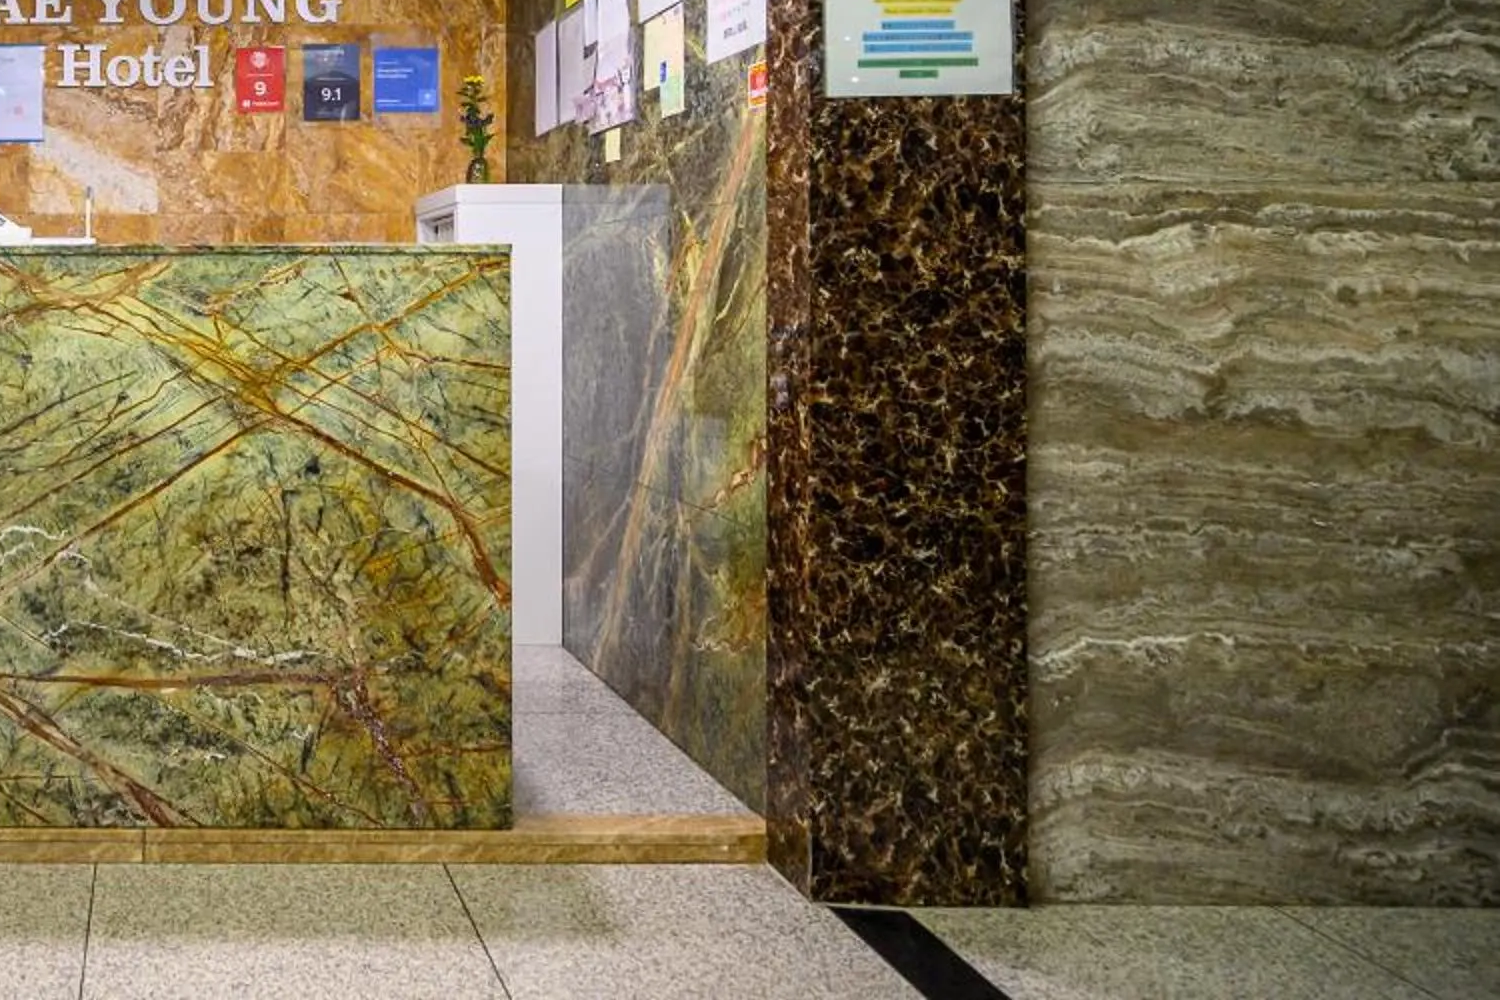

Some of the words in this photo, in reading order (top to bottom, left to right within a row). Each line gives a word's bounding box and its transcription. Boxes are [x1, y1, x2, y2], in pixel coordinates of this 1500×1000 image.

[57, 44, 214, 89] Hotel
[253, 81, 267, 96] 9
[321, 87, 342, 101] 9.1
